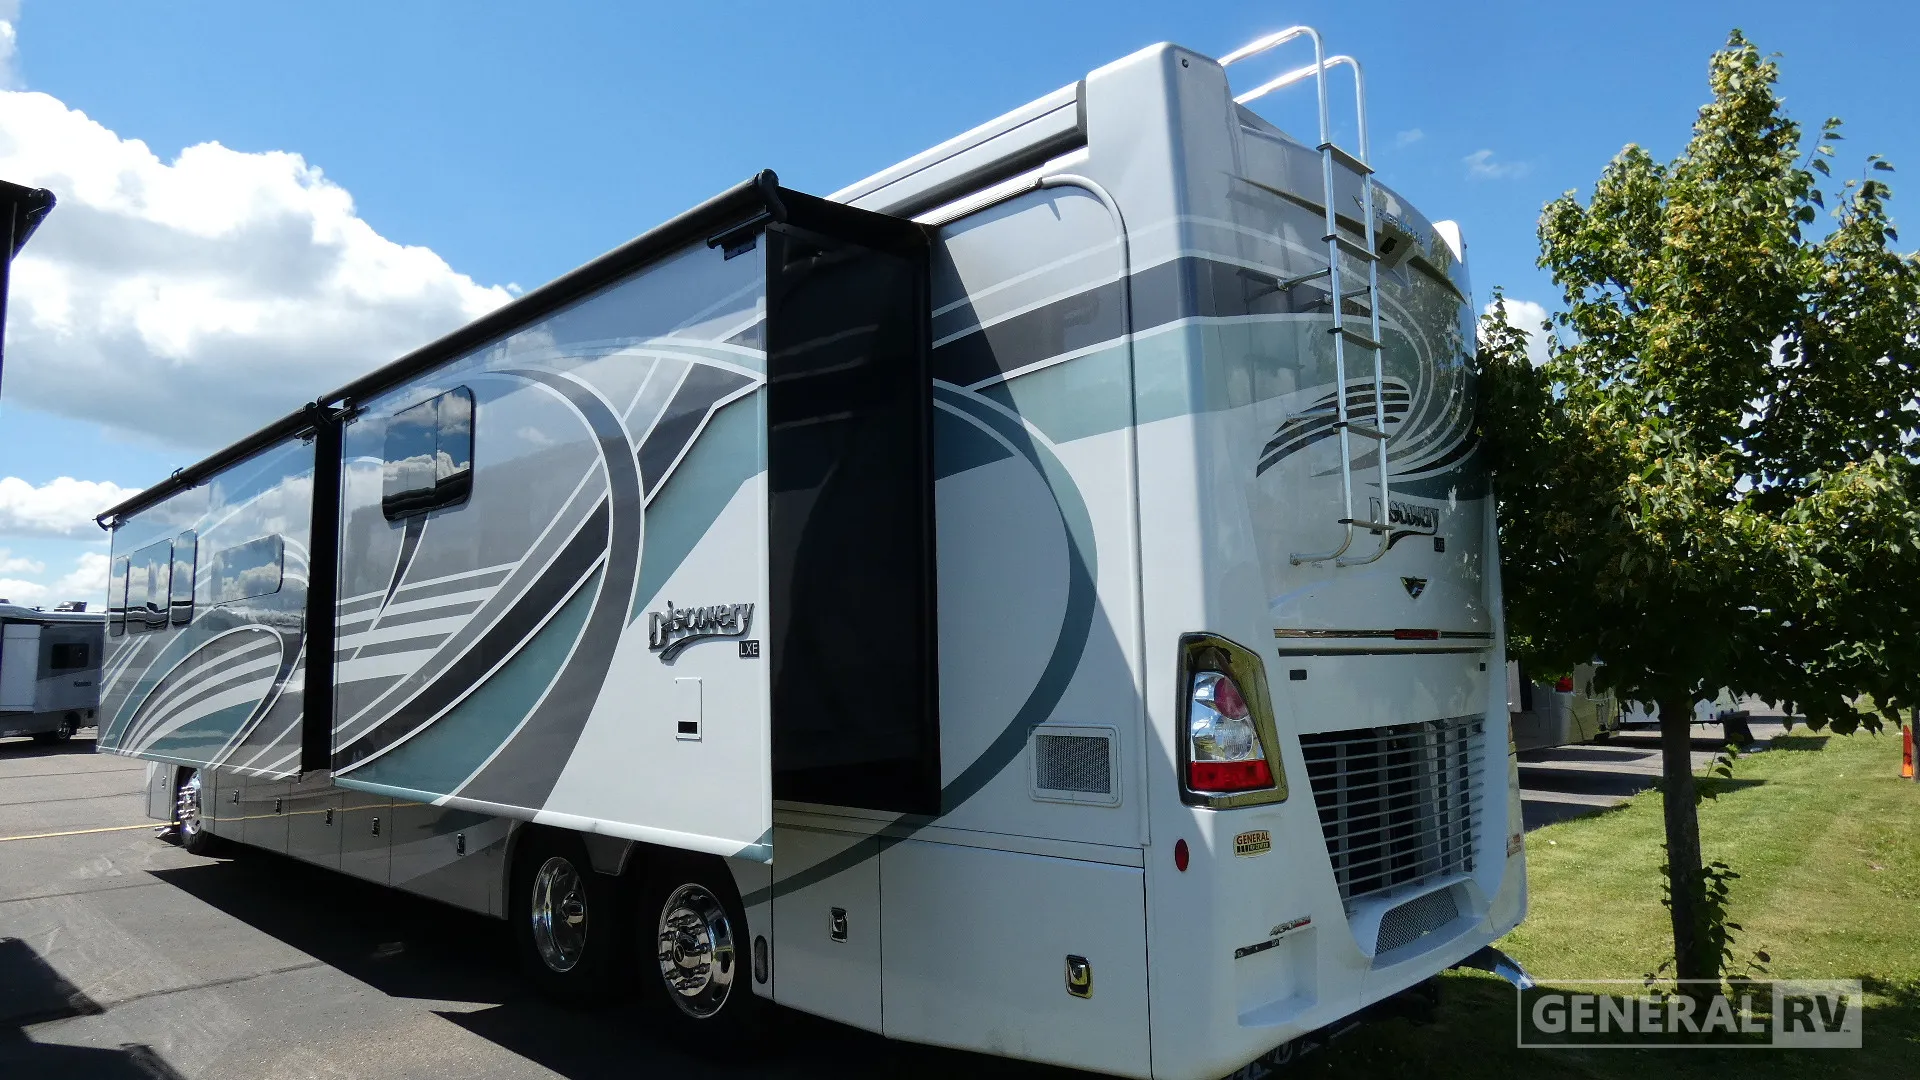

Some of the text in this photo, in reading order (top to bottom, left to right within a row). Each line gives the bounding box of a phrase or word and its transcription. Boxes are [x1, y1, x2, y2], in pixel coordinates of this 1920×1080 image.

[648, 600, 754, 661] Discovery
[740, 642, 758, 655] LXE
[1236, 831, 1270, 845] GENERAL
